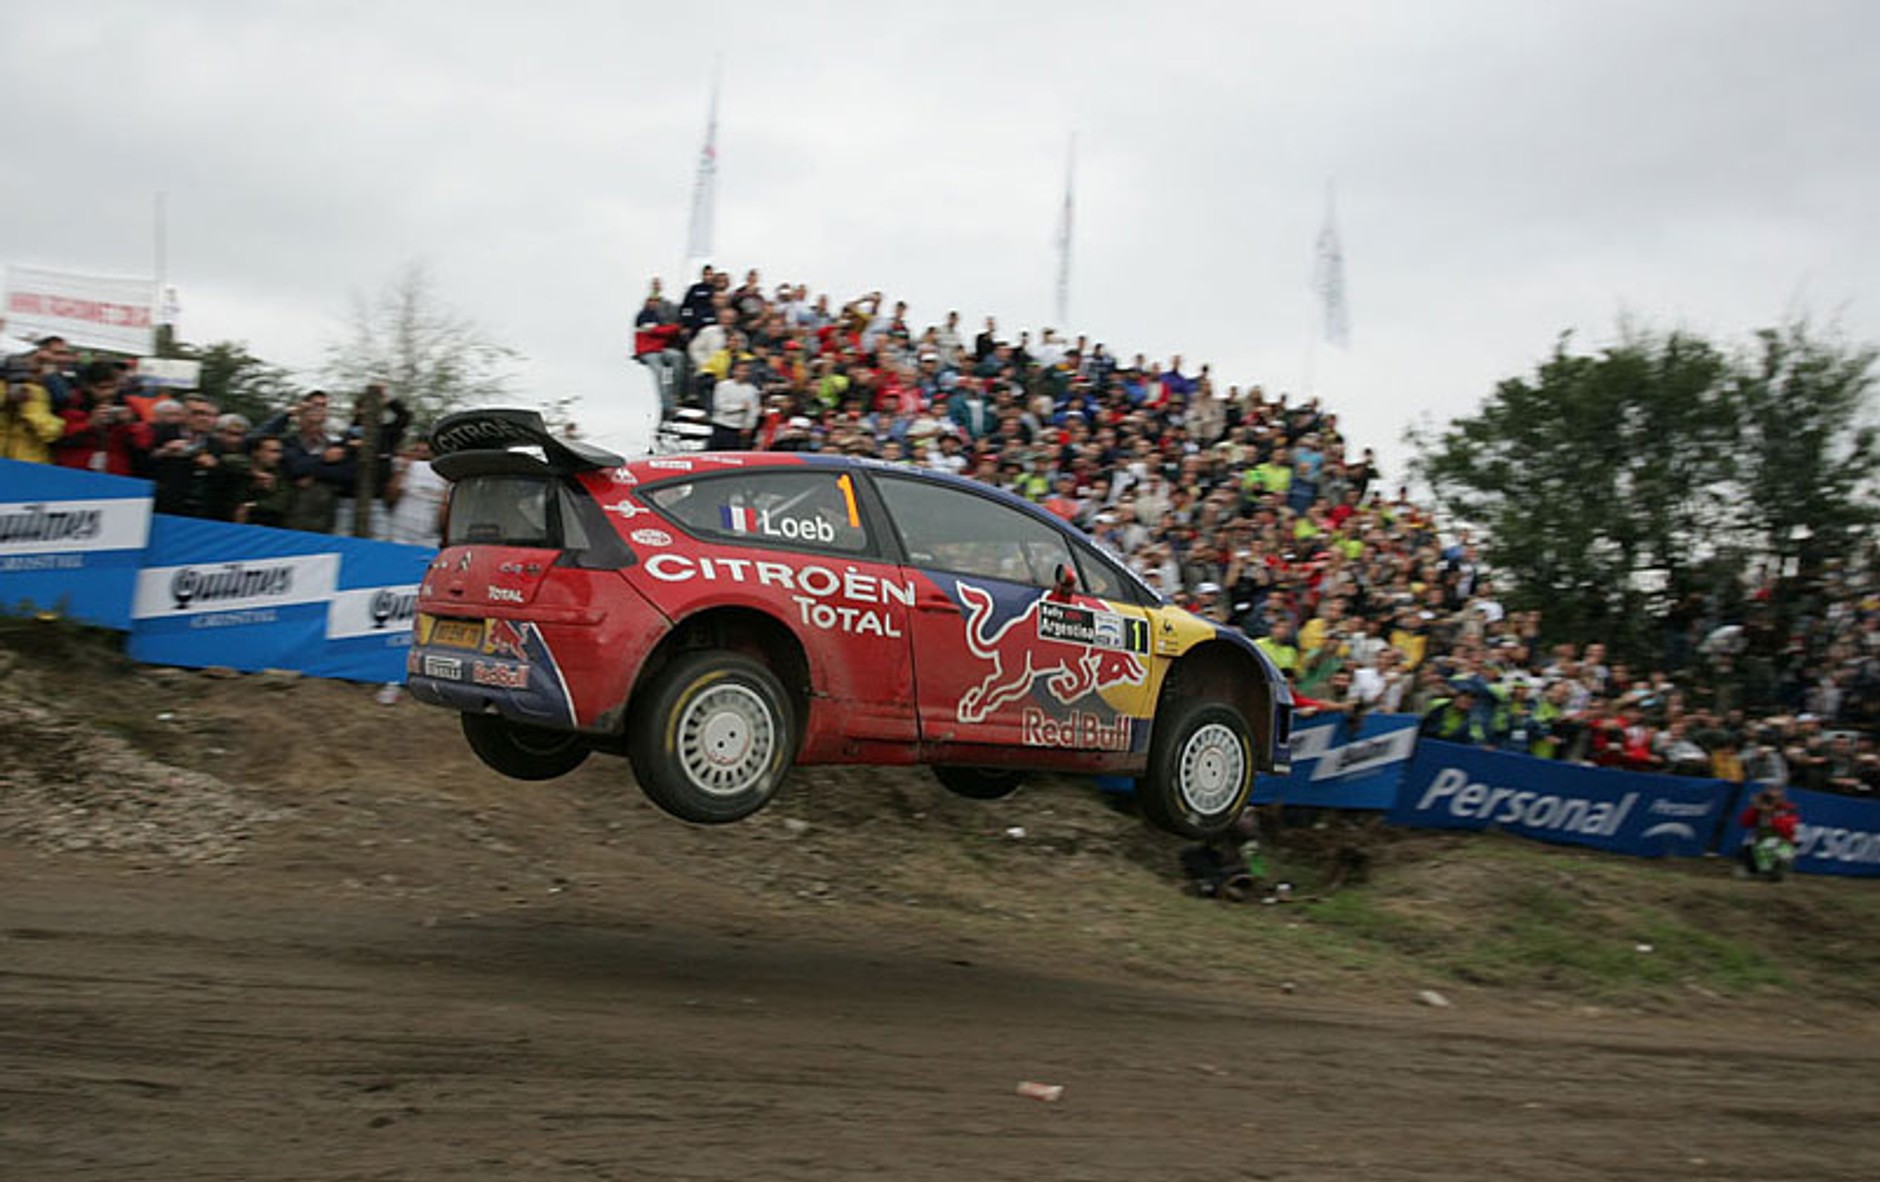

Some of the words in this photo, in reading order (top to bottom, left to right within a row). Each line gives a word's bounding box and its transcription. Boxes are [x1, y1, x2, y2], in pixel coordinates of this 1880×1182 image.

[836, 474, 860, 528] 1
[0, 505, 102, 543] uilmes
[763, 509, 834, 543] Loeb
[488, 583, 525, 604] TOTAL
[644, 553, 916, 608] CITROËN
[792, 594, 902, 638] TOTAL
[1041, 617, 1095, 639] Argentina
[1132, 620, 1141, 652] 1
[1022, 706, 1080, 747] Red
[1080, 711, 1132, 748] Bull
[1416, 767, 1640, 837] Personal
